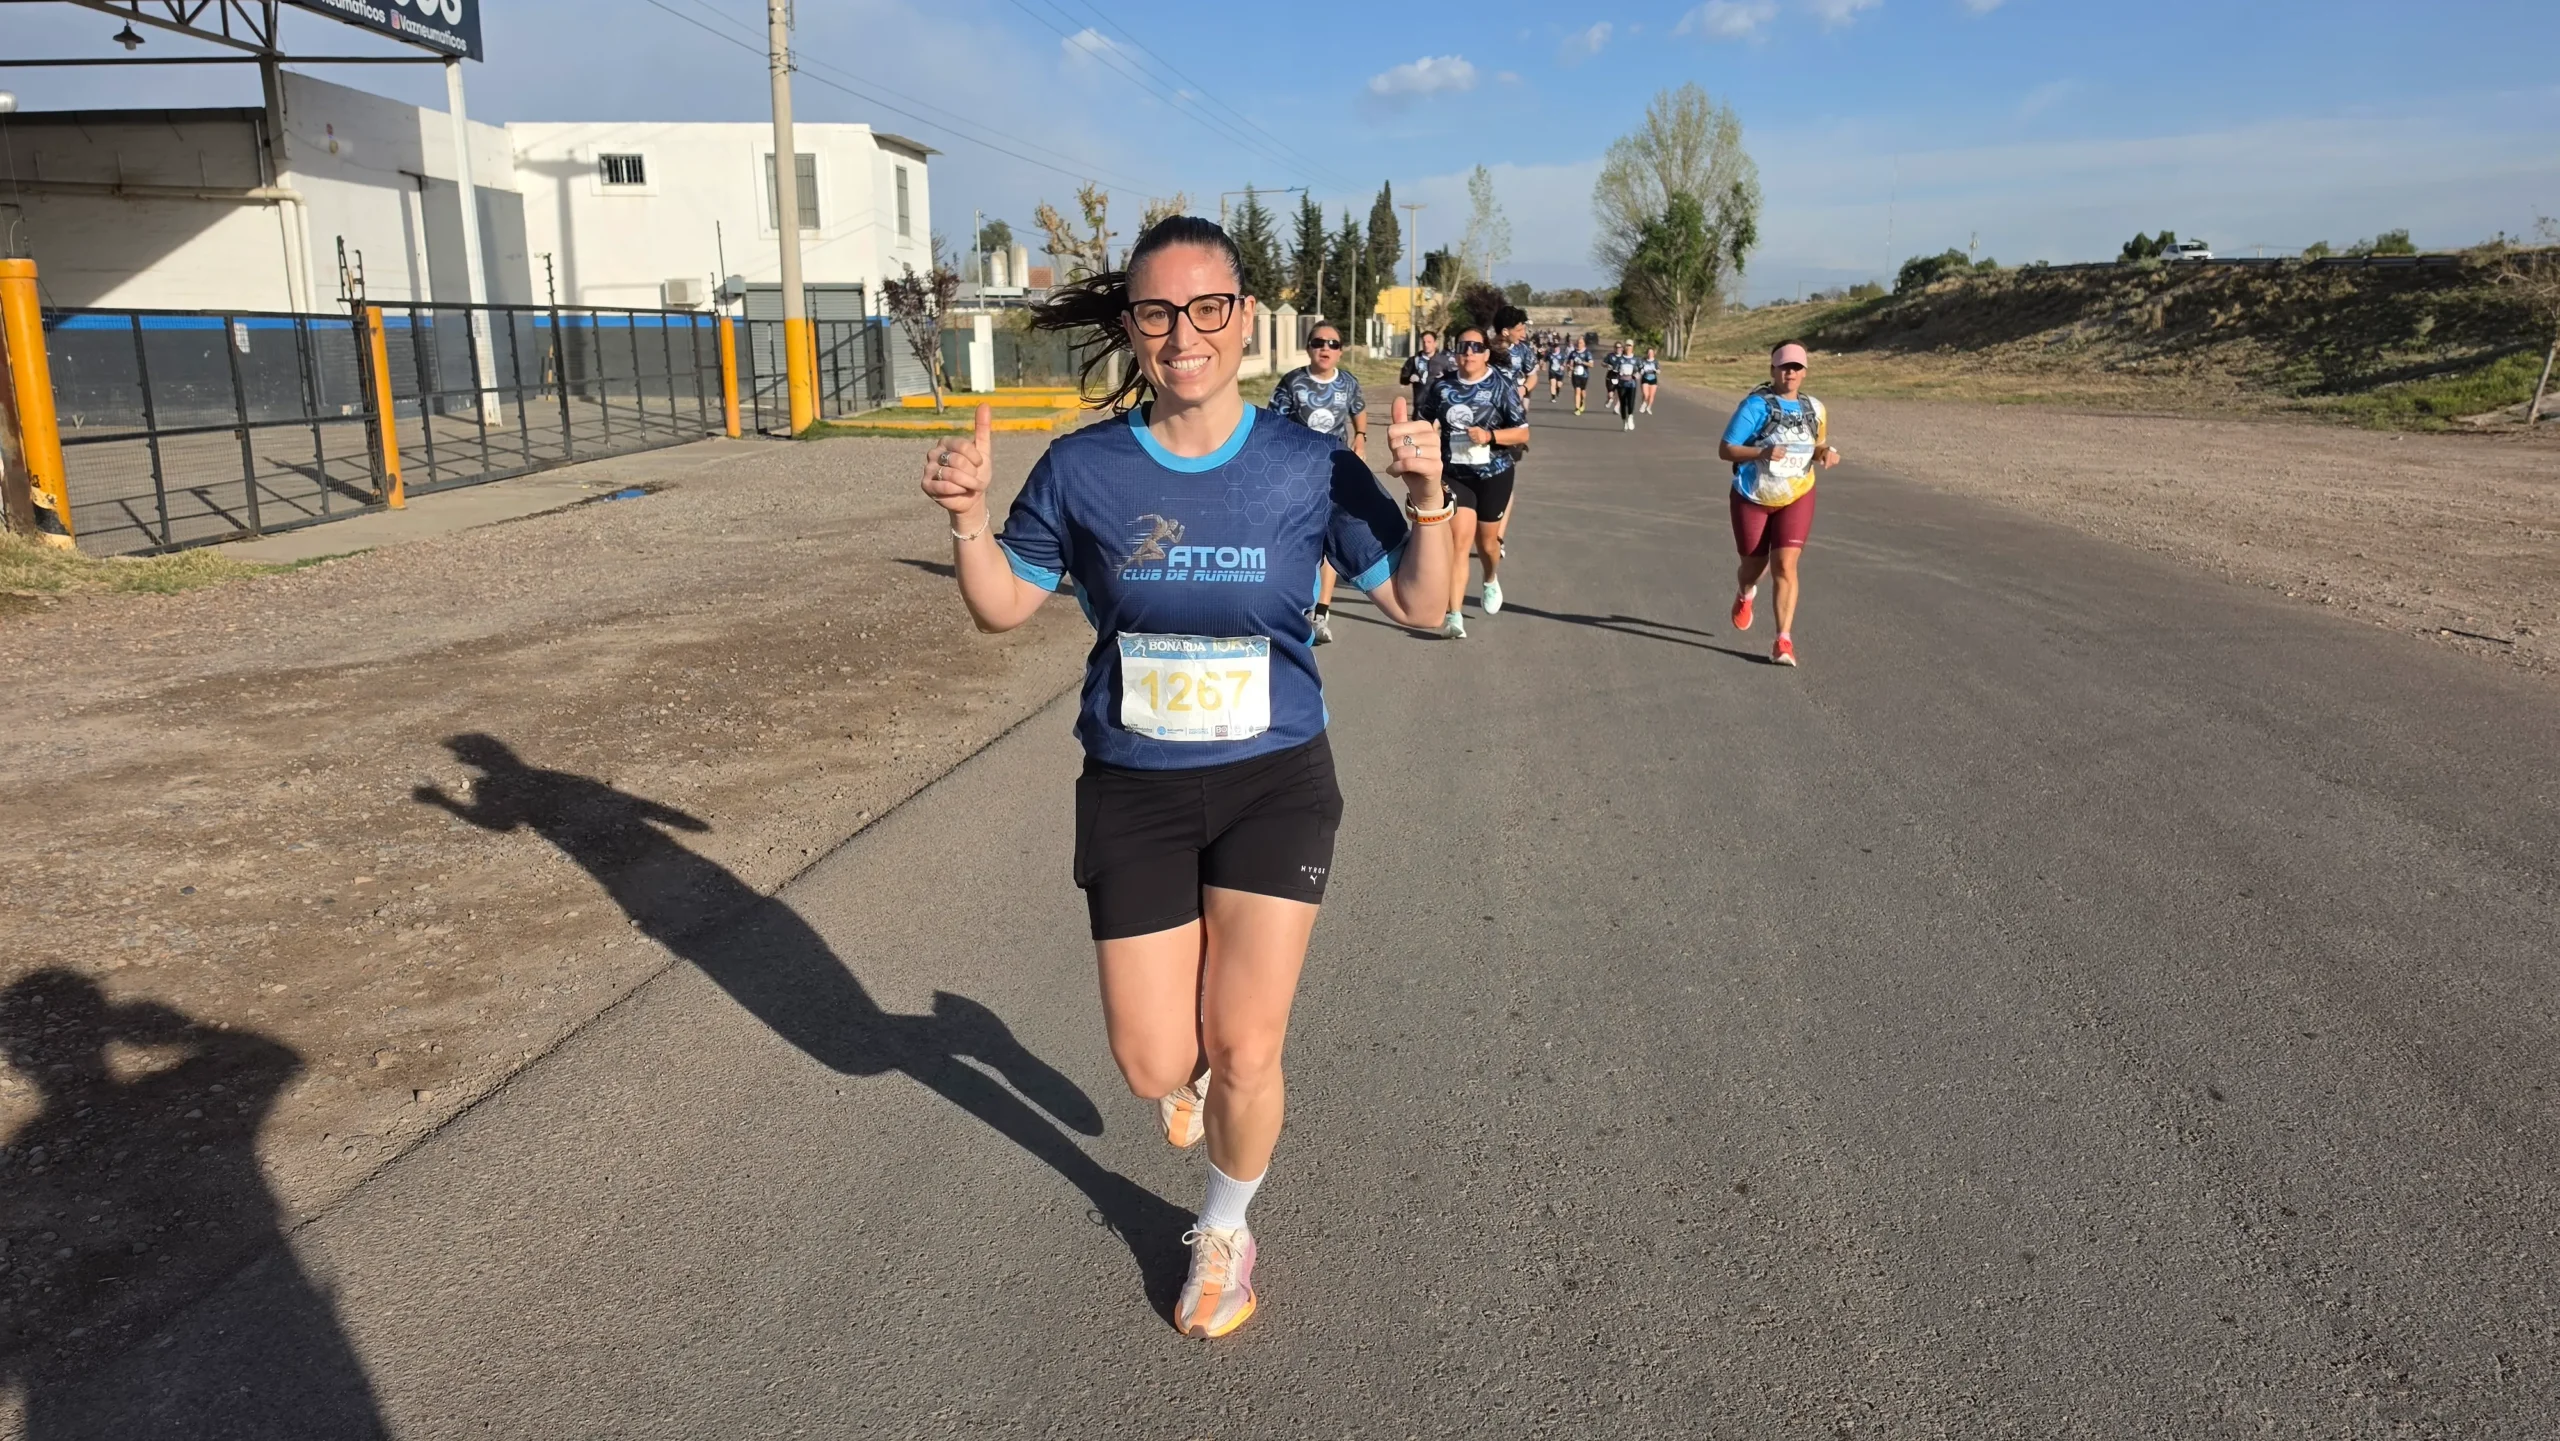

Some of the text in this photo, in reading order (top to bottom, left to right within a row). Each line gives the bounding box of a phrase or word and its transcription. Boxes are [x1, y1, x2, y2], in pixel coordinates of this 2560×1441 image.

[321, 0, 386, 23] umaticos
[399, 13, 467, 51] Vazneumaticos
[1168, 546, 1266, 569] ATOM
[1122, 569, 1266, 582] CLUB DE RUNNING
[1149, 641, 1207, 652] BONARDA
[1141, 670, 1252, 711] 1267
